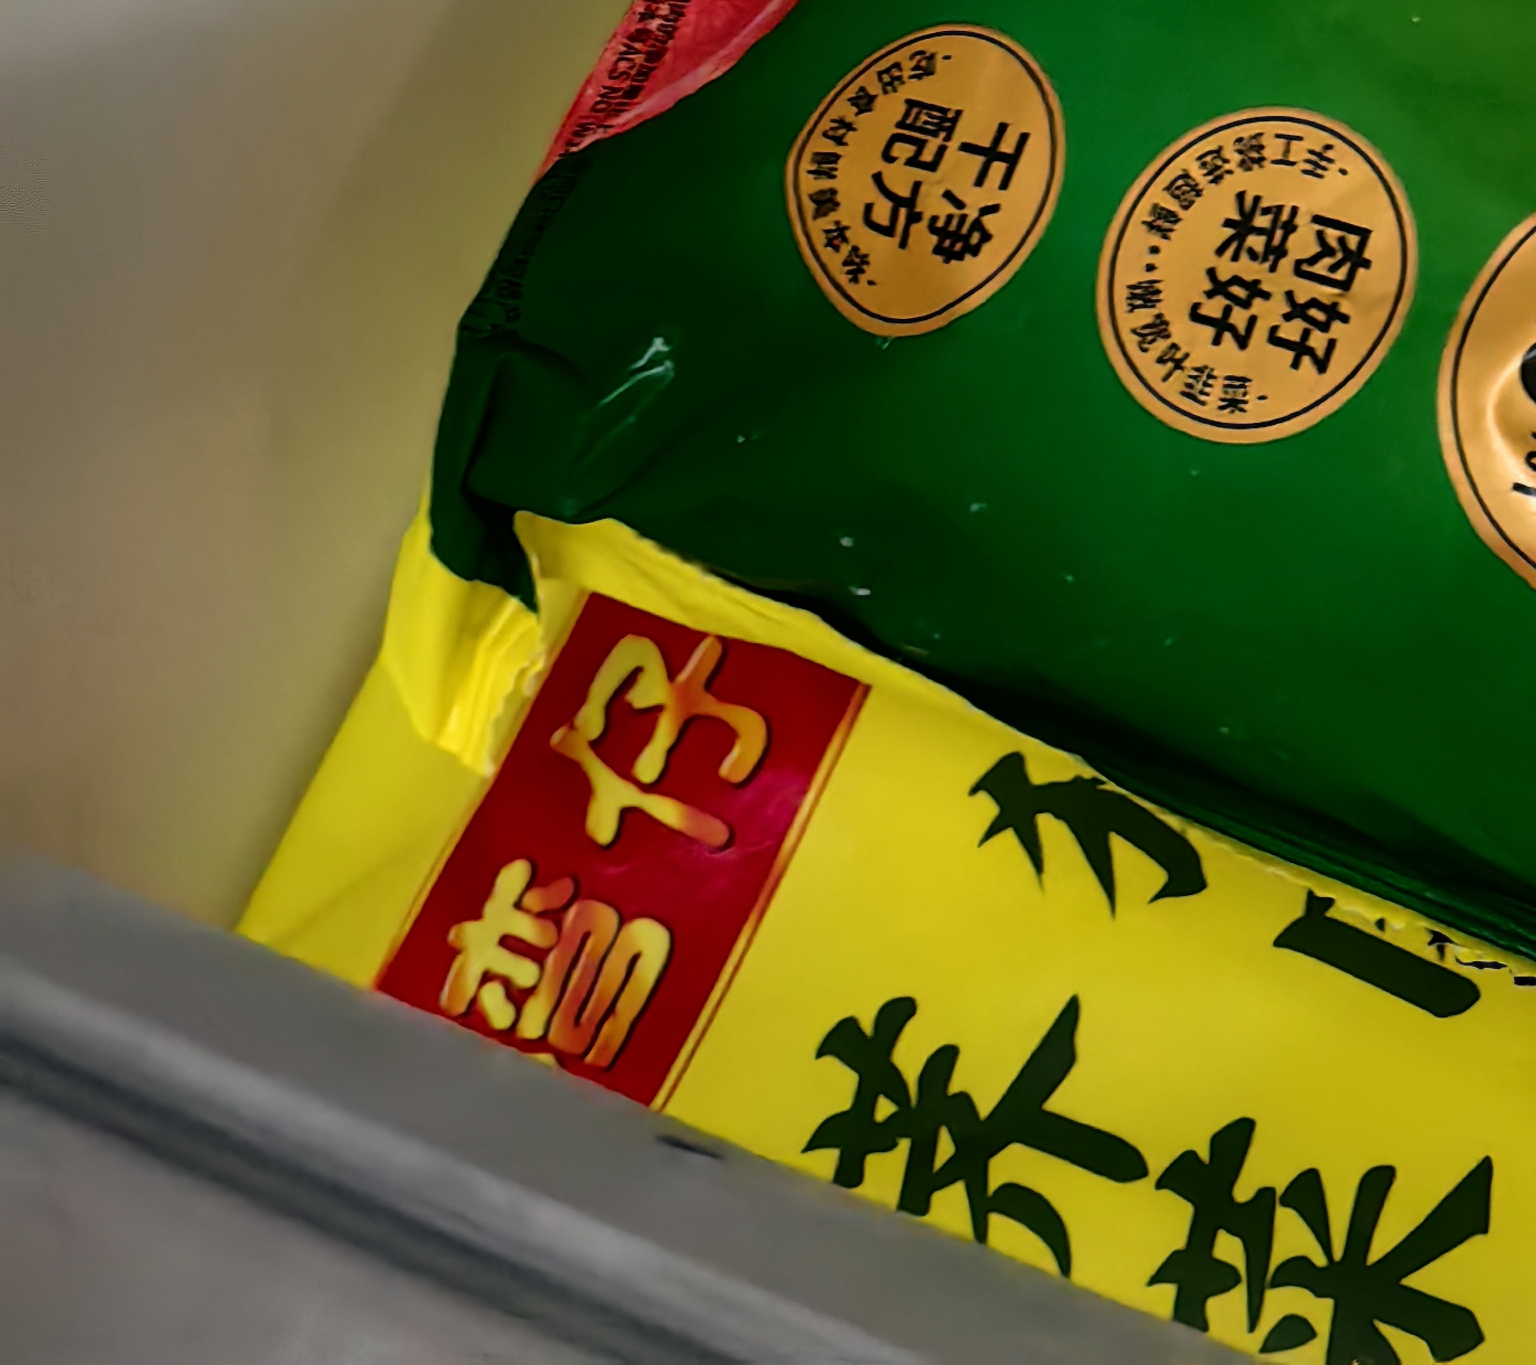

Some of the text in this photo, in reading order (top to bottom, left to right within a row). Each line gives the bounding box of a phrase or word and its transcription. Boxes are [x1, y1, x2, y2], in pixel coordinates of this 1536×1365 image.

[862, 97, 964, 250] 配方
[927, 121, 1031, 264] 干净
[1188, 189, 1299, 351] 菜好
[1265, 214, 1372, 375] 肉好
